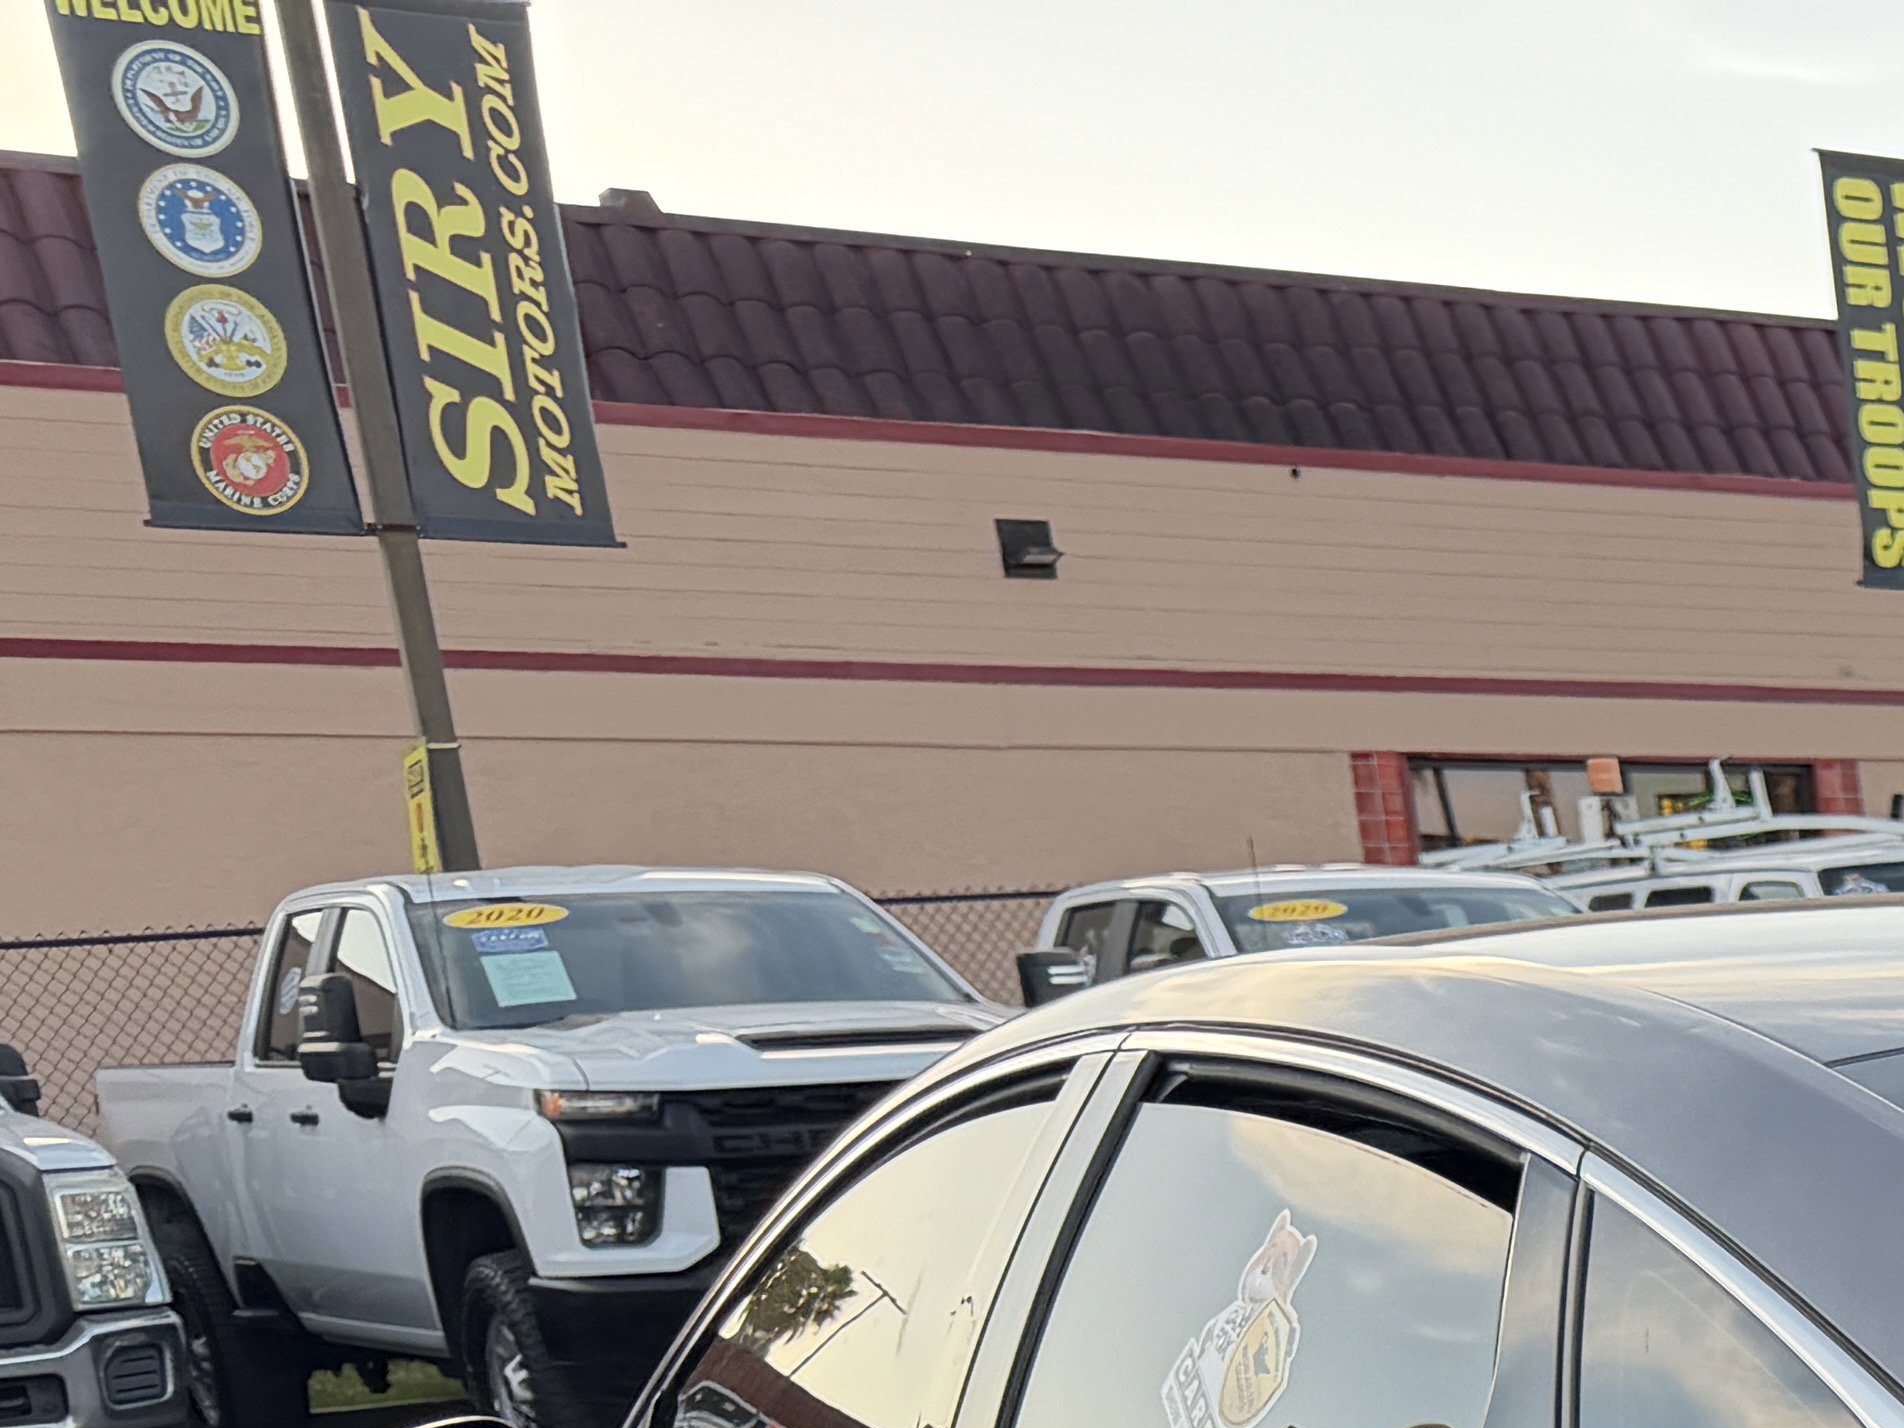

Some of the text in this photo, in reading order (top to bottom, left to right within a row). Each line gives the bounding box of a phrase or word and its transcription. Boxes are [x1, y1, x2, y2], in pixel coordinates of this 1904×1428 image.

[356, 4, 537, 518] SIRY
[1832, 176, 1893, 309] OUR
[198, 413, 296, 453] UNITED STATES
[206, 470, 301, 508] MARINE CORPS
[467, 906, 545, 925] 2020
